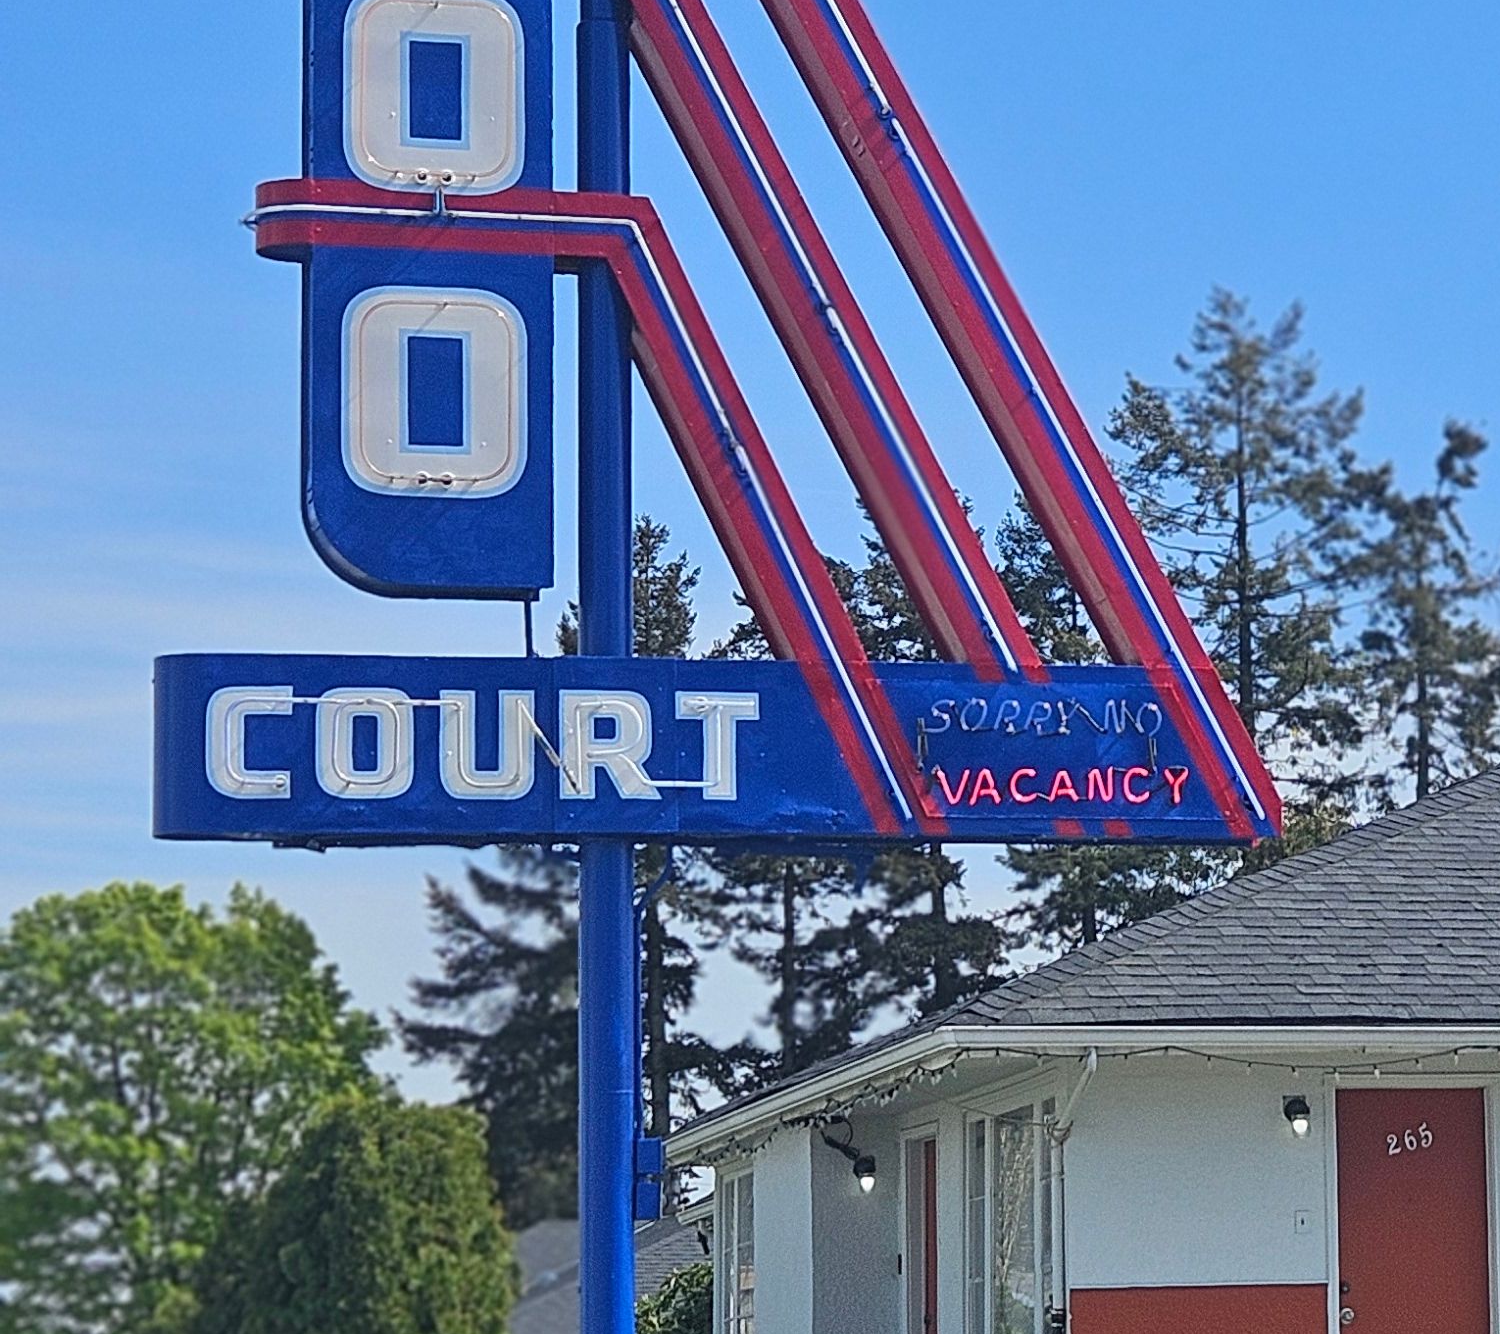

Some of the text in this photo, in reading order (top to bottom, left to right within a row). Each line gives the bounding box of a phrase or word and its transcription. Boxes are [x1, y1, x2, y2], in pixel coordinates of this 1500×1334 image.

[926, 697, 1163, 736] SORRY NO
[205, 685, 760, 802] COURT
[935, 765, 1189, 806] VACANCY
[1386, 1121, 1434, 1156] 265
